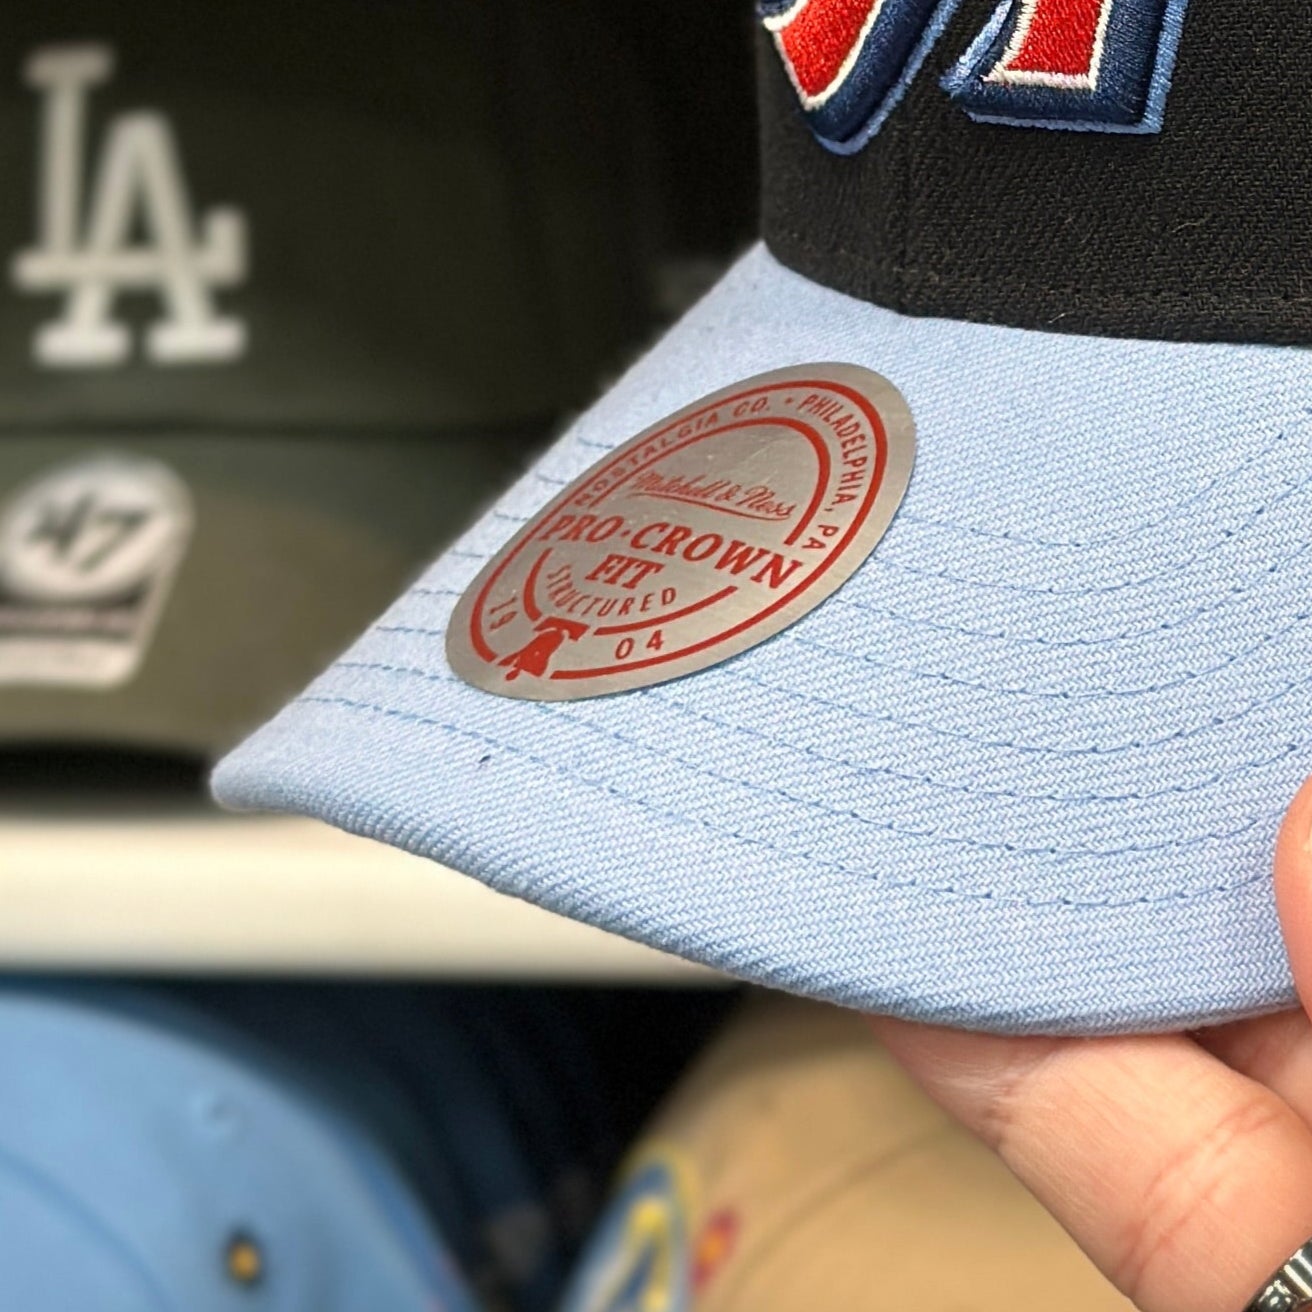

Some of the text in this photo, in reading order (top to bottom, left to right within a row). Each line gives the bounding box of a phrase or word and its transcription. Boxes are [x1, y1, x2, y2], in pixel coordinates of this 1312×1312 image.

[14, 45, 247, 366] LA
[802, 524, 840, 549] PA
[547, 564, 677, 617] STRUCTURED
[585, 554, 666, 589] FIT
